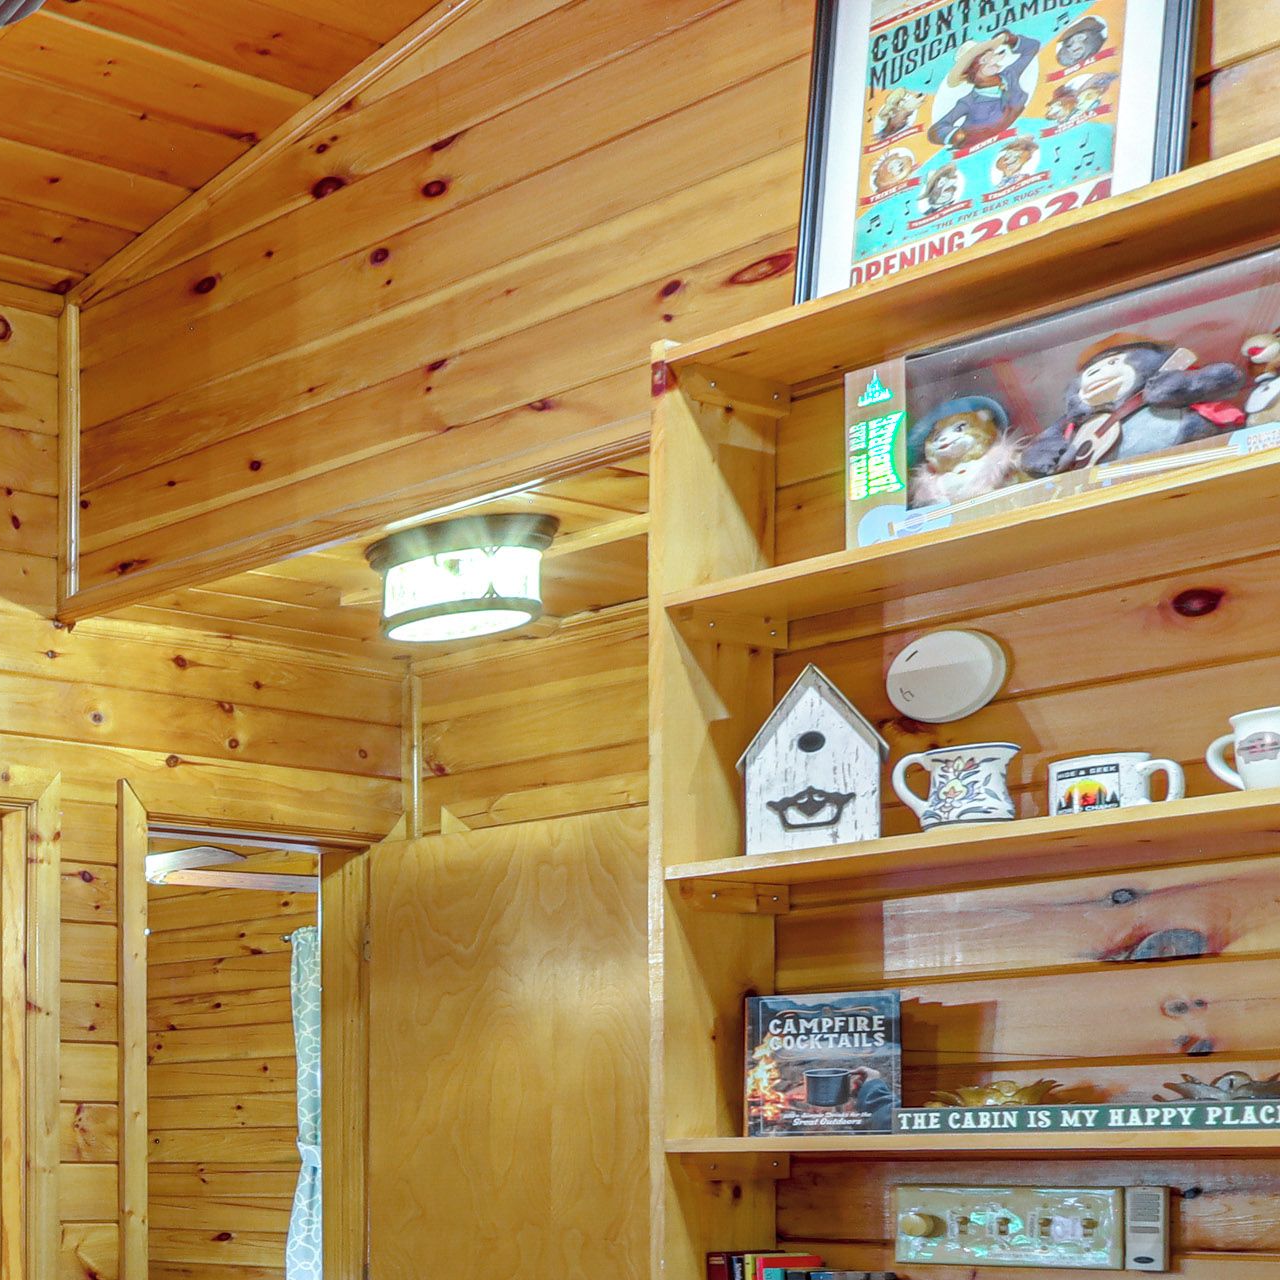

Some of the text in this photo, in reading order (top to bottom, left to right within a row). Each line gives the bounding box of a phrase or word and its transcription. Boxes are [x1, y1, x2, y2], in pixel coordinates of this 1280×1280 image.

[867, 24, 974, 99] MUSICAL
[958, 210, 979, 222] FIVE
[982, 199, 1009, 214] BEAR
[850, 233, 965, 288] OPENING
[970, 178, 1113, 243] 2024
[1089, 765, 1116, 775] SEEK
[769, 1015, 886, 1034] CAMPFIRE
[770, 1032, 886, 1050] COCKTAILS
[819, 1117, 862, 1126] Outdoors
[898, 1104, 1280, 1130] THE CABIN IS MY HAPPY PLAC
